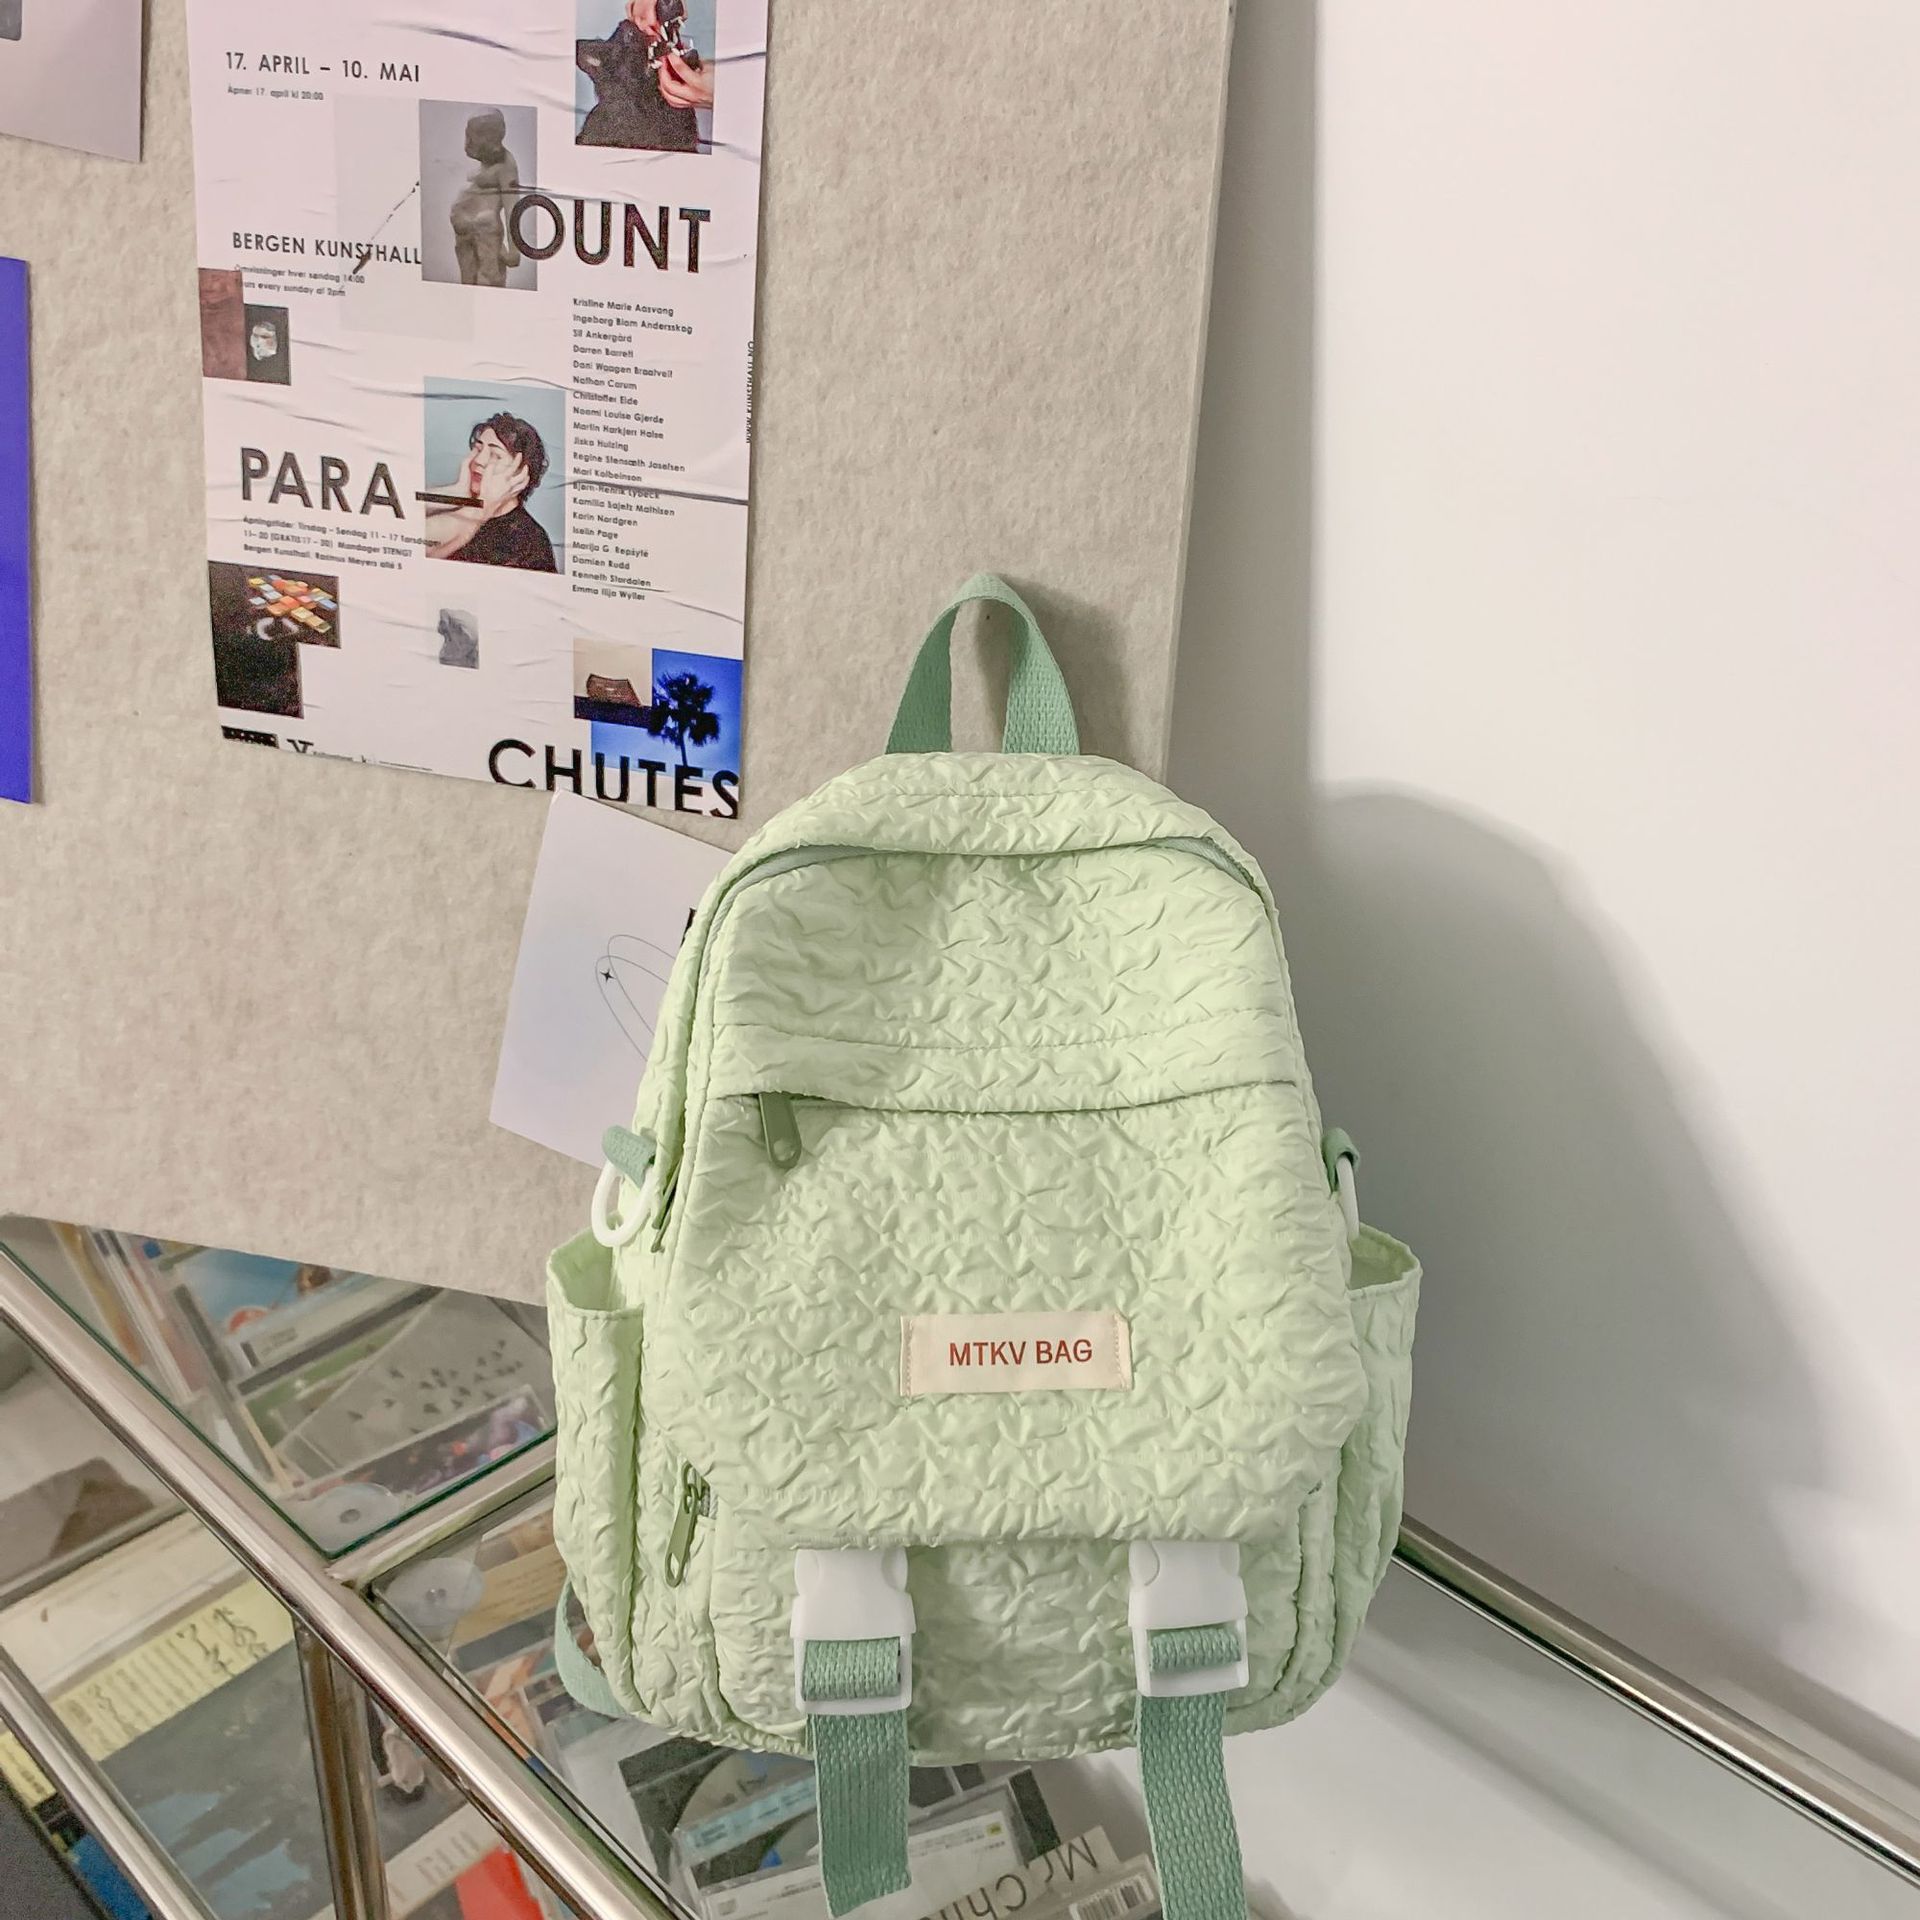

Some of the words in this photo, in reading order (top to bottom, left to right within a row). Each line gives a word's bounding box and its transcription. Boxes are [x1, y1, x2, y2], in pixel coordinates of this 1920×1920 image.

[226, 52, 246, 70] 17.
[258, 54, 310, 75] APRIL
[342, 60, 368, 79] 10.
[379, 62, 420, 83] MAI
[509, 194, 711, 274] OUNT
[232, 231, 306, 255] BERGEN
[315, 239, 422, 265] KUNSTHALL
[258, 283, 281, 292] every
[284, 285, 313, 295] sunday
[573, 297, 604, 309] Kristine
[607, 301, 632, 311] Marie
[635, 304, 674, 317] Aasvang
[573, 314, 613, 327] Ingeborg
[573, 344, 602, 355] Darren
[620, 396, 638, 406] Eide
[604, 409, 631, 420] Louise
[634, 413, 664, 424] Gjerde
[573, 422, 600, 432] Martin
[573, 452, 602, 463] Regine
[573, 511, 594, 521] Karin
[597, 529, 618, 541] Page
[573, 556, 605, 567] Damien
[608, 560, 630, 570] Rudd
[573, 570, 607, 581] Kenneth
[573, 585, 599, 595] Emma
[488, 738, 739, 819] CHUTES
[949, 1340, 1027, 1366] MTKV
[1035, 1339, 1093, 1364] BAG
